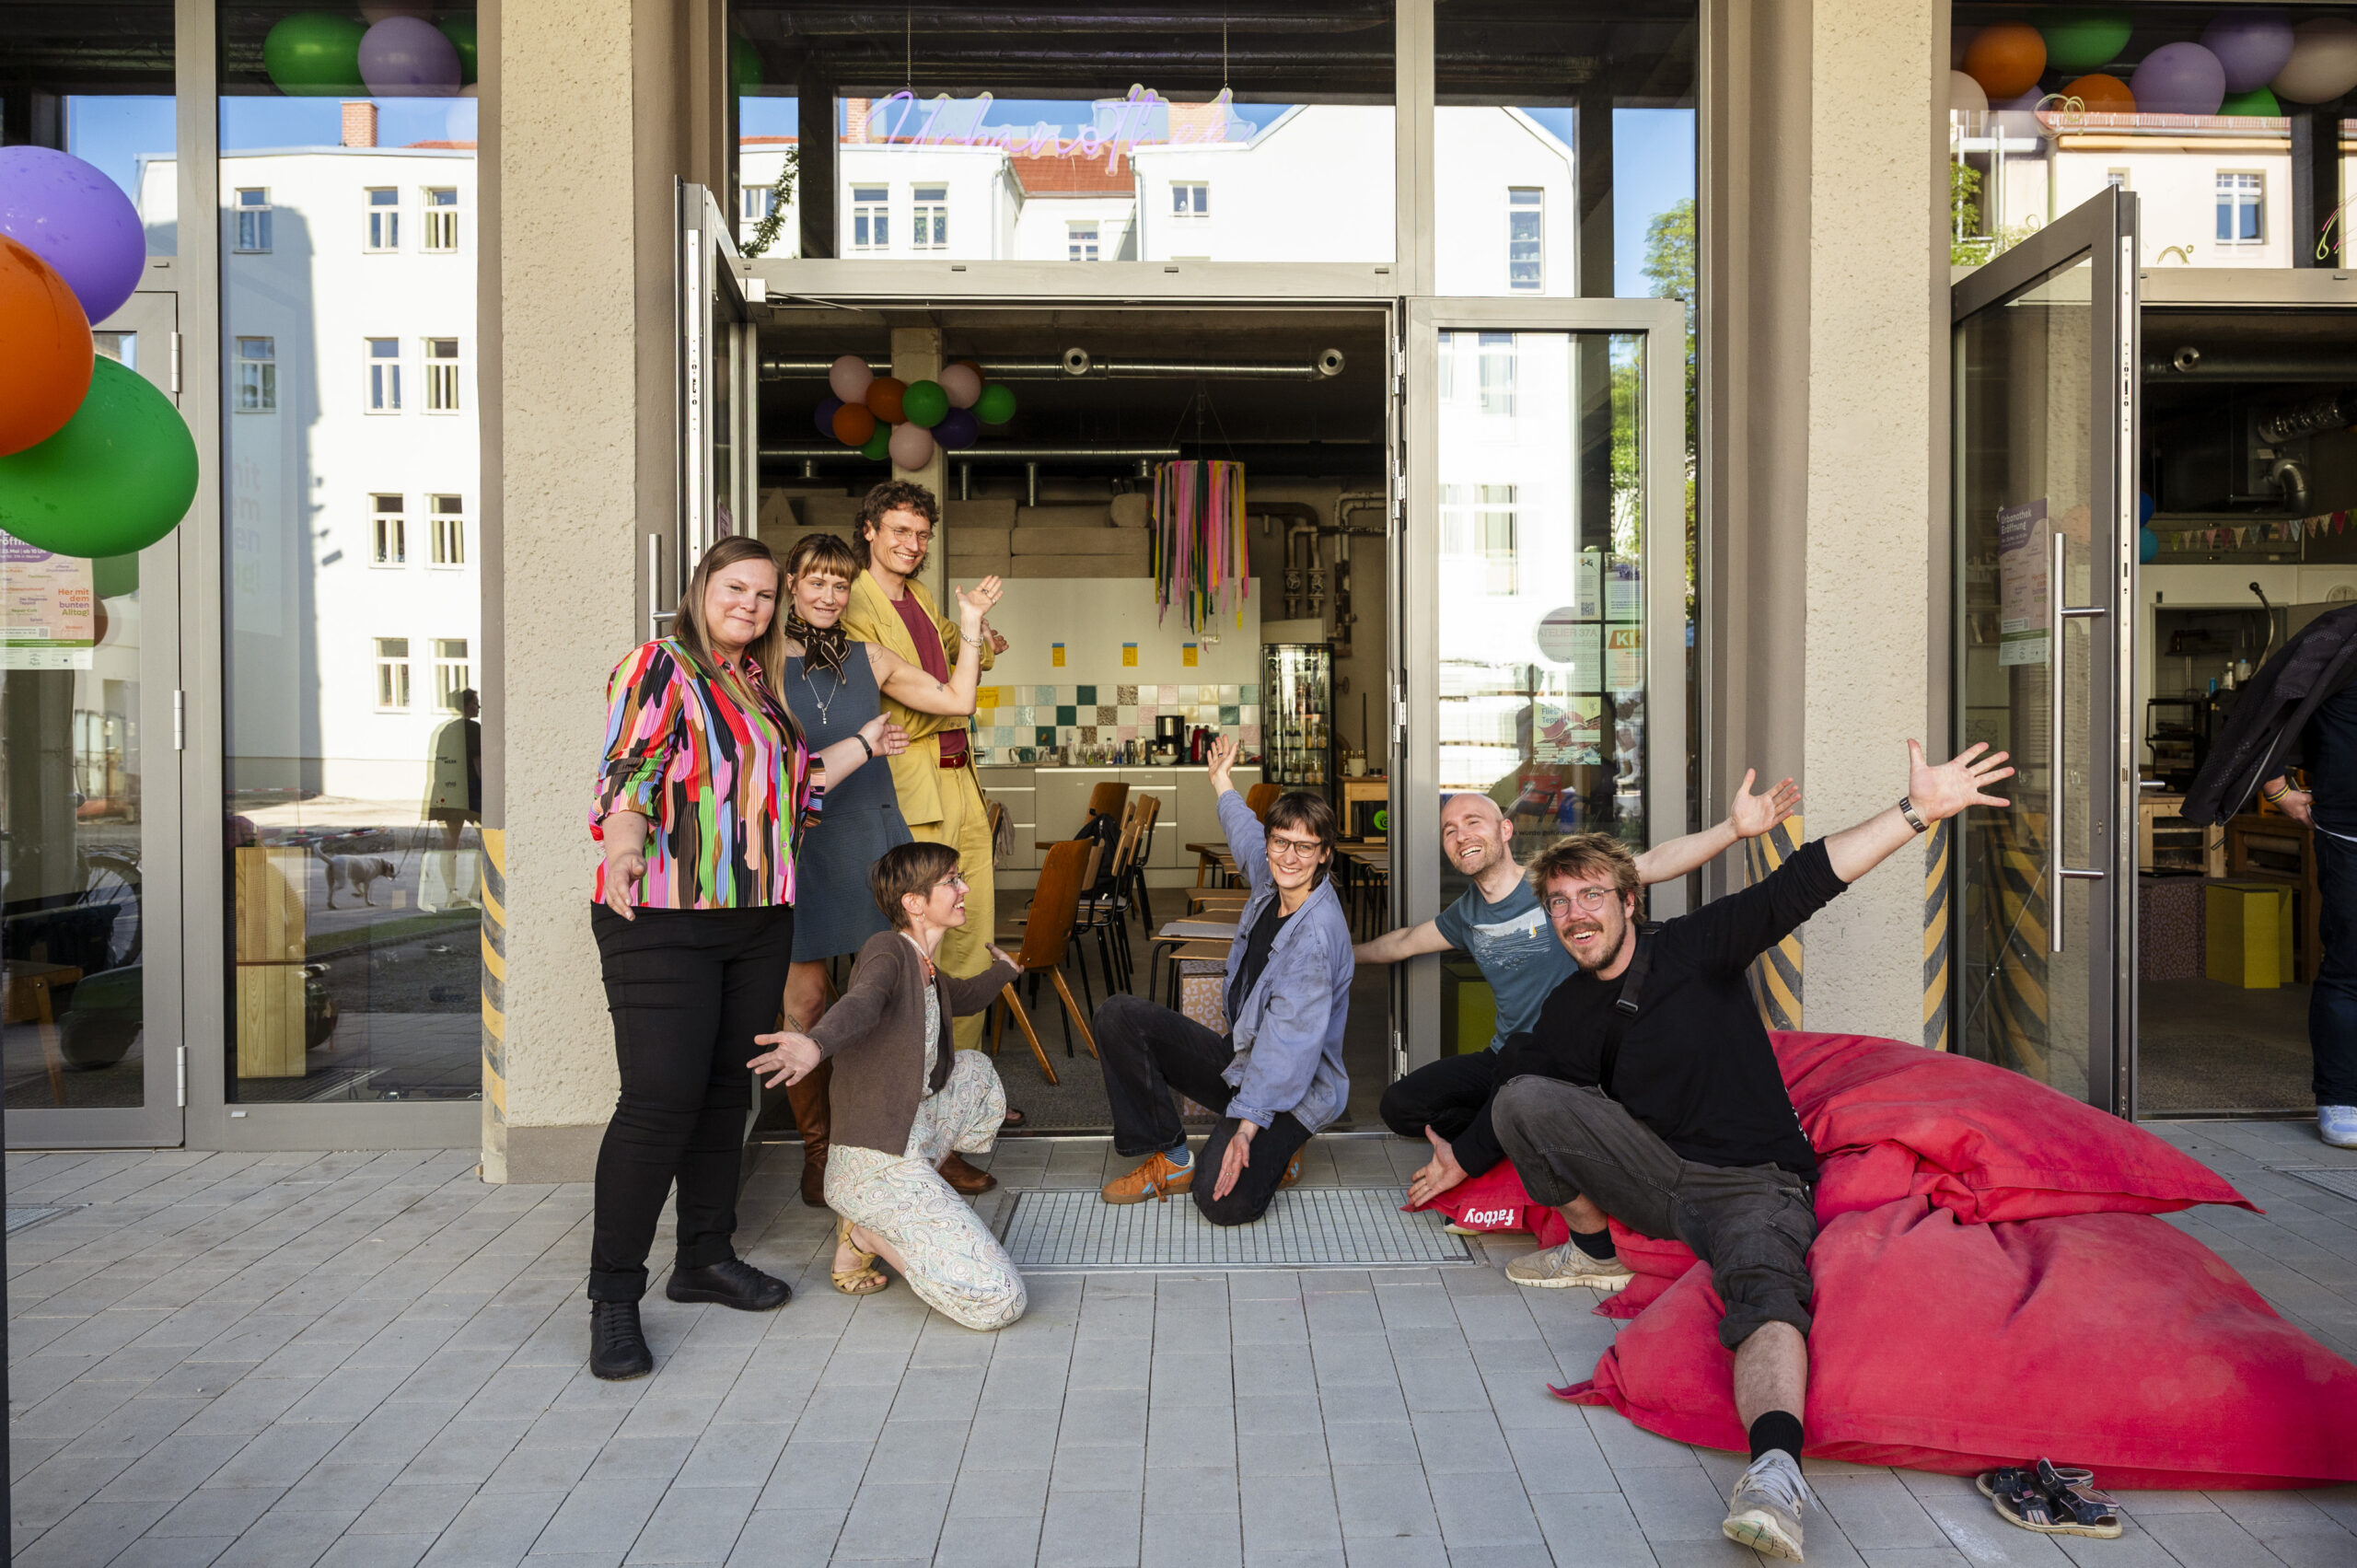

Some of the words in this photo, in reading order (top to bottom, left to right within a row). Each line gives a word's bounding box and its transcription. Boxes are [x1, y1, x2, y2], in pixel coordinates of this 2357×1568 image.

[75, 587, 89, 596] mit
[62, 609, 89, 617] Alltag!
[1579, 628, 1598, 637] 37A
[1463, 1208, 1515, 1227] fatboy
